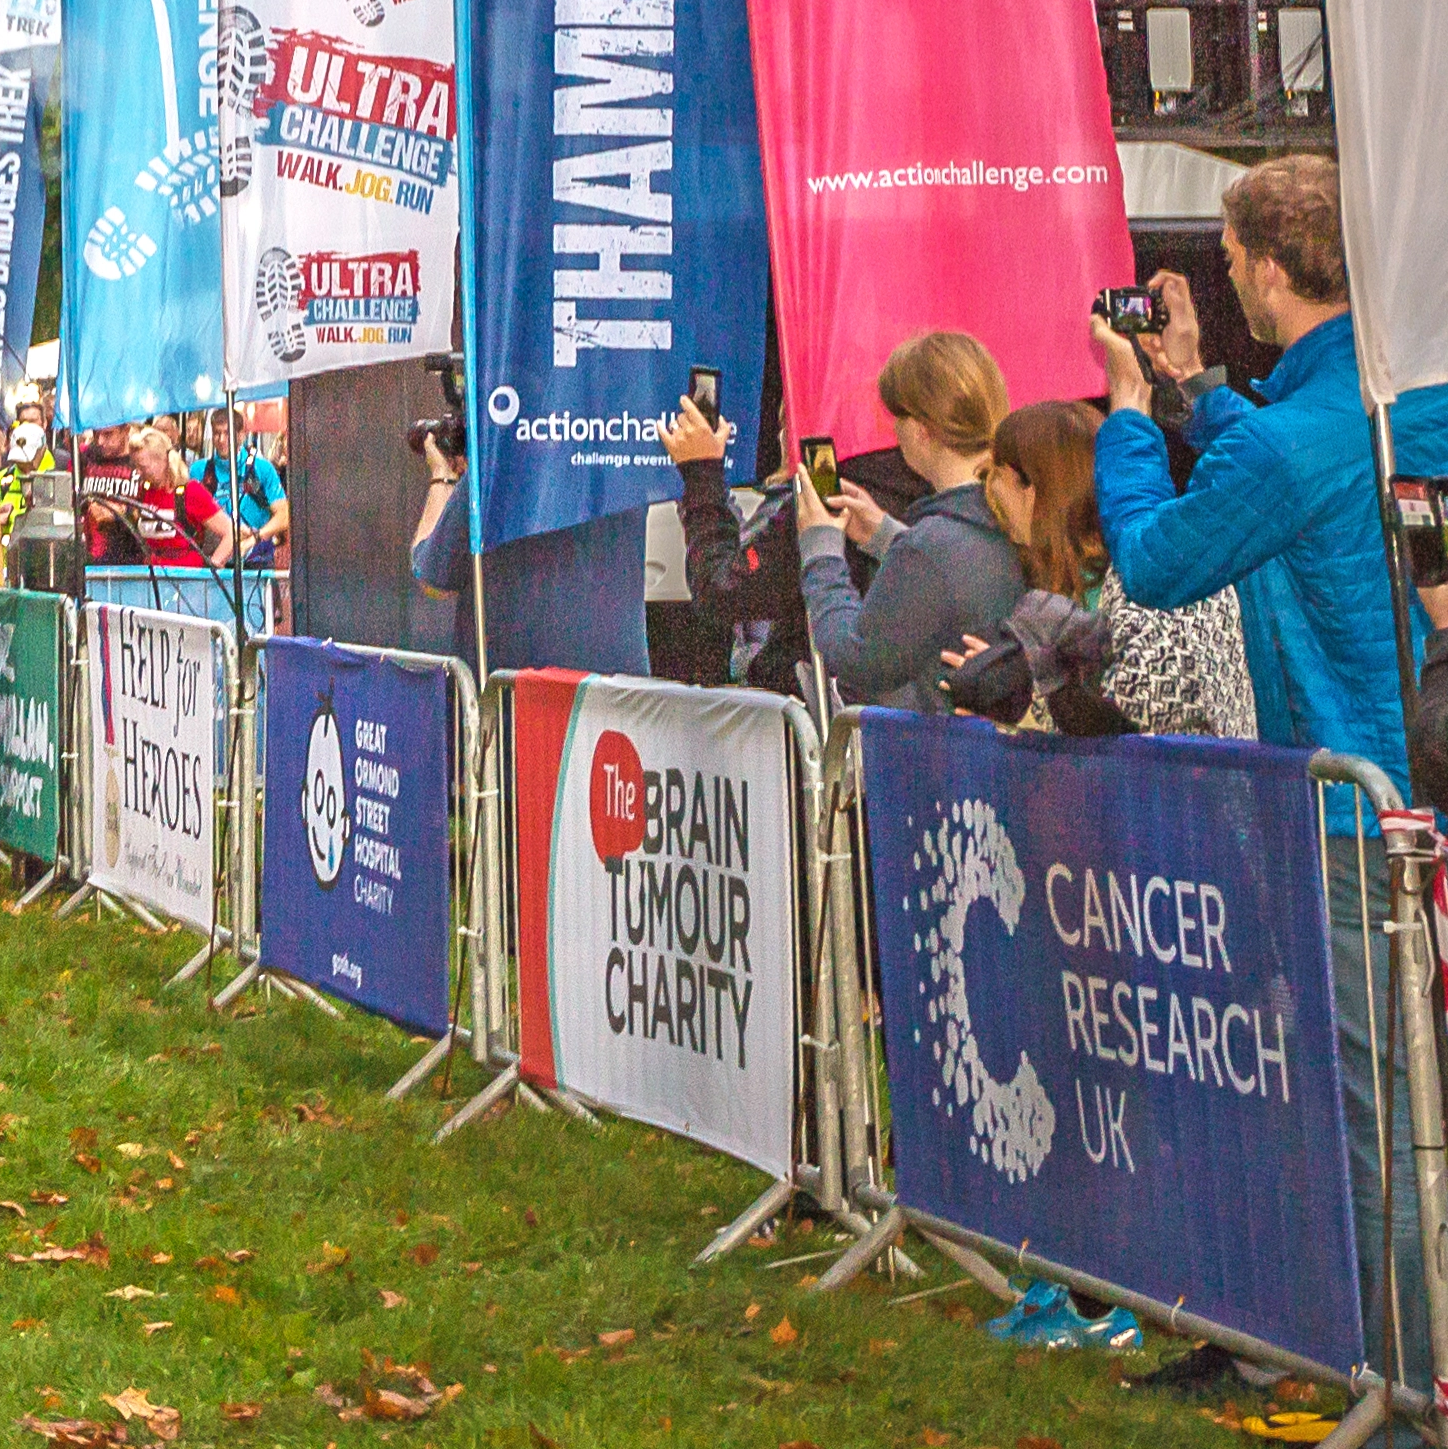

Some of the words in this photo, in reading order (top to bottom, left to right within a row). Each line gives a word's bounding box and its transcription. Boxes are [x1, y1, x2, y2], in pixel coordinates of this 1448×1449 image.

[286, 46, 450, 141] ULTRA
[279, 105, 444, 180] CHALLENGE
[807, 160, 1109, 196] www.actionchallenge.com
[309, 261, 415, 298] ULTRA
[313, 298, 413, 322] CHALLENGE
[516, 410, 738, 444] actionchalle
[570, 451, 631, 467] challenge
[119, 607, 170, 710] HELP
[173, 627, 201, 739] for
[354, 719, 387, 755] GREAT
[122, 716, 202, 841] HEROES
[354, 755, 400, 800] ORMOND
[602, 762, 637, 823] The
[355, 795, 391, 835] STREET
[643, 770, 749, 873] BRAIN
[354, 833, 402, 880] HOSPITAL
[354, 874, 394, 916] CHARITY
[604, 860, 751, 973] TUMOUR
[1045, 863, 1232, 973] CANCER
[605, 949, 752, 1071] CHARITY
[1061, 970, 1290, 1103] RESEARCH
[1075, 1078, 1135, 1174] UK
